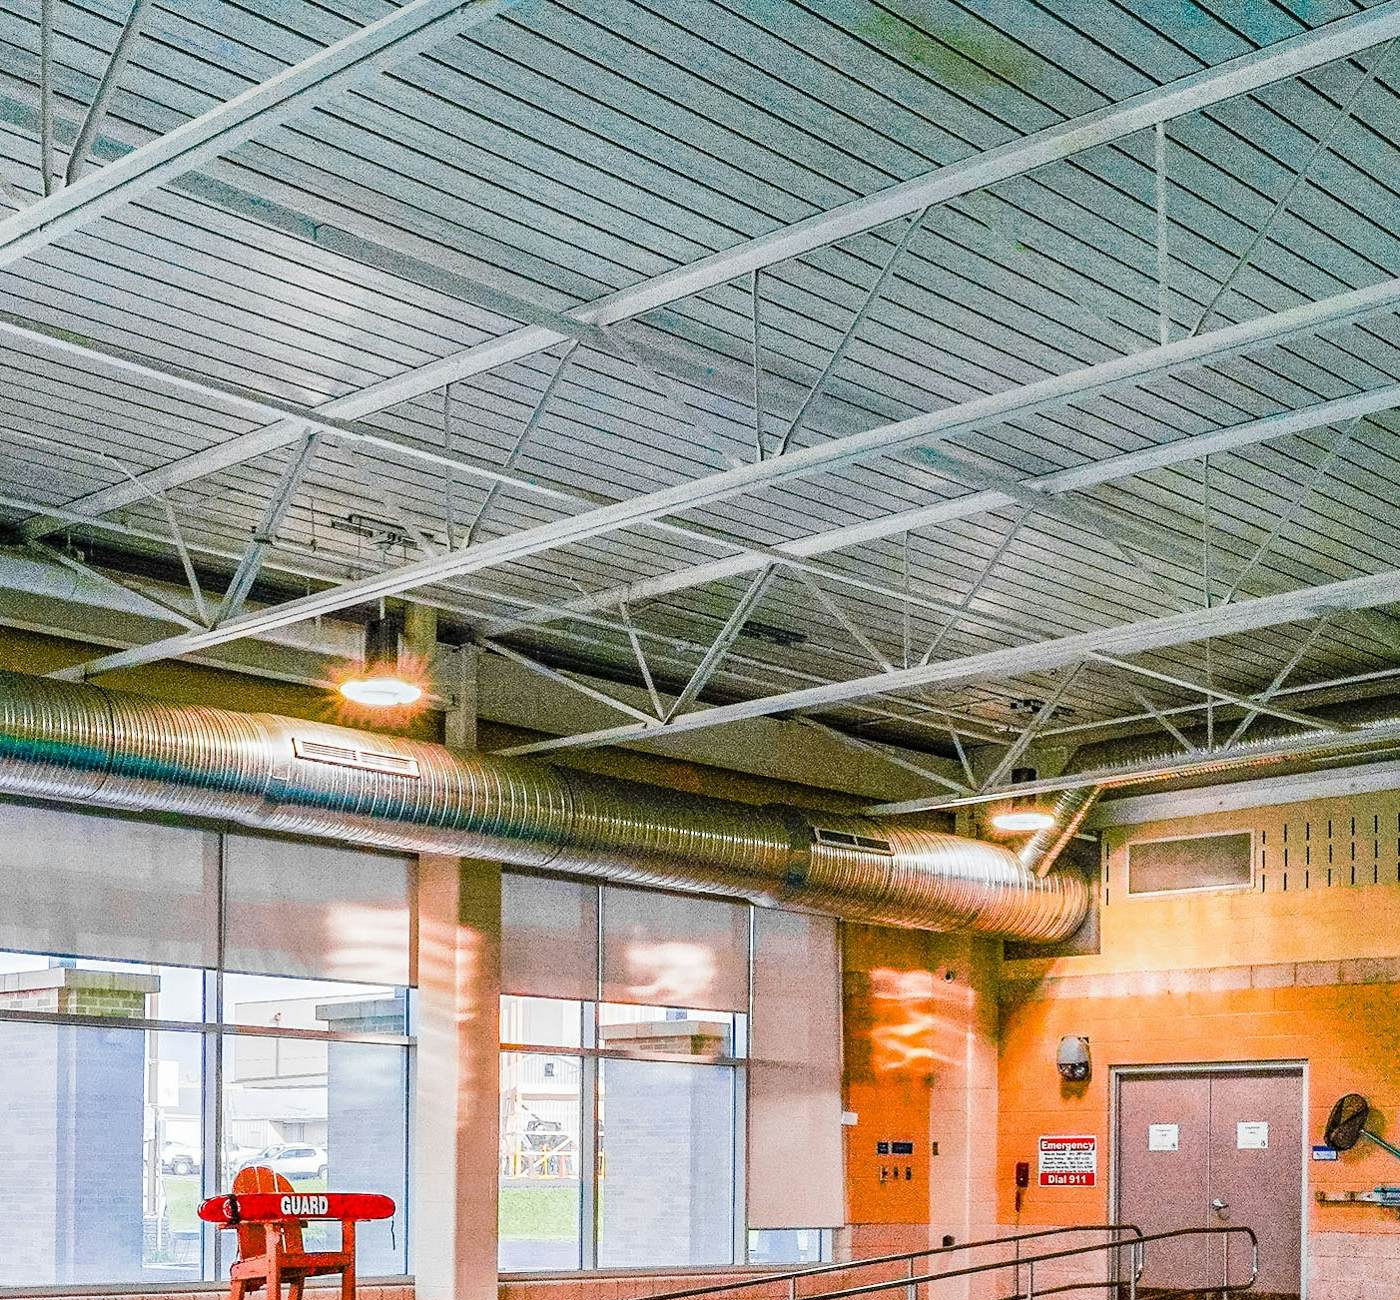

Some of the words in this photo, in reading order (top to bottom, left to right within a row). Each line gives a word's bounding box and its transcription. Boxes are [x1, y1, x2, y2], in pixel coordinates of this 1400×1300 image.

[1041, 1140, 1094, 1151] Emergency
[1048, 1174, 1067, 1184] Dial
[1069, 1174, 1087, 1184] 911
[280, 1195, 329, 1215] GUARD
